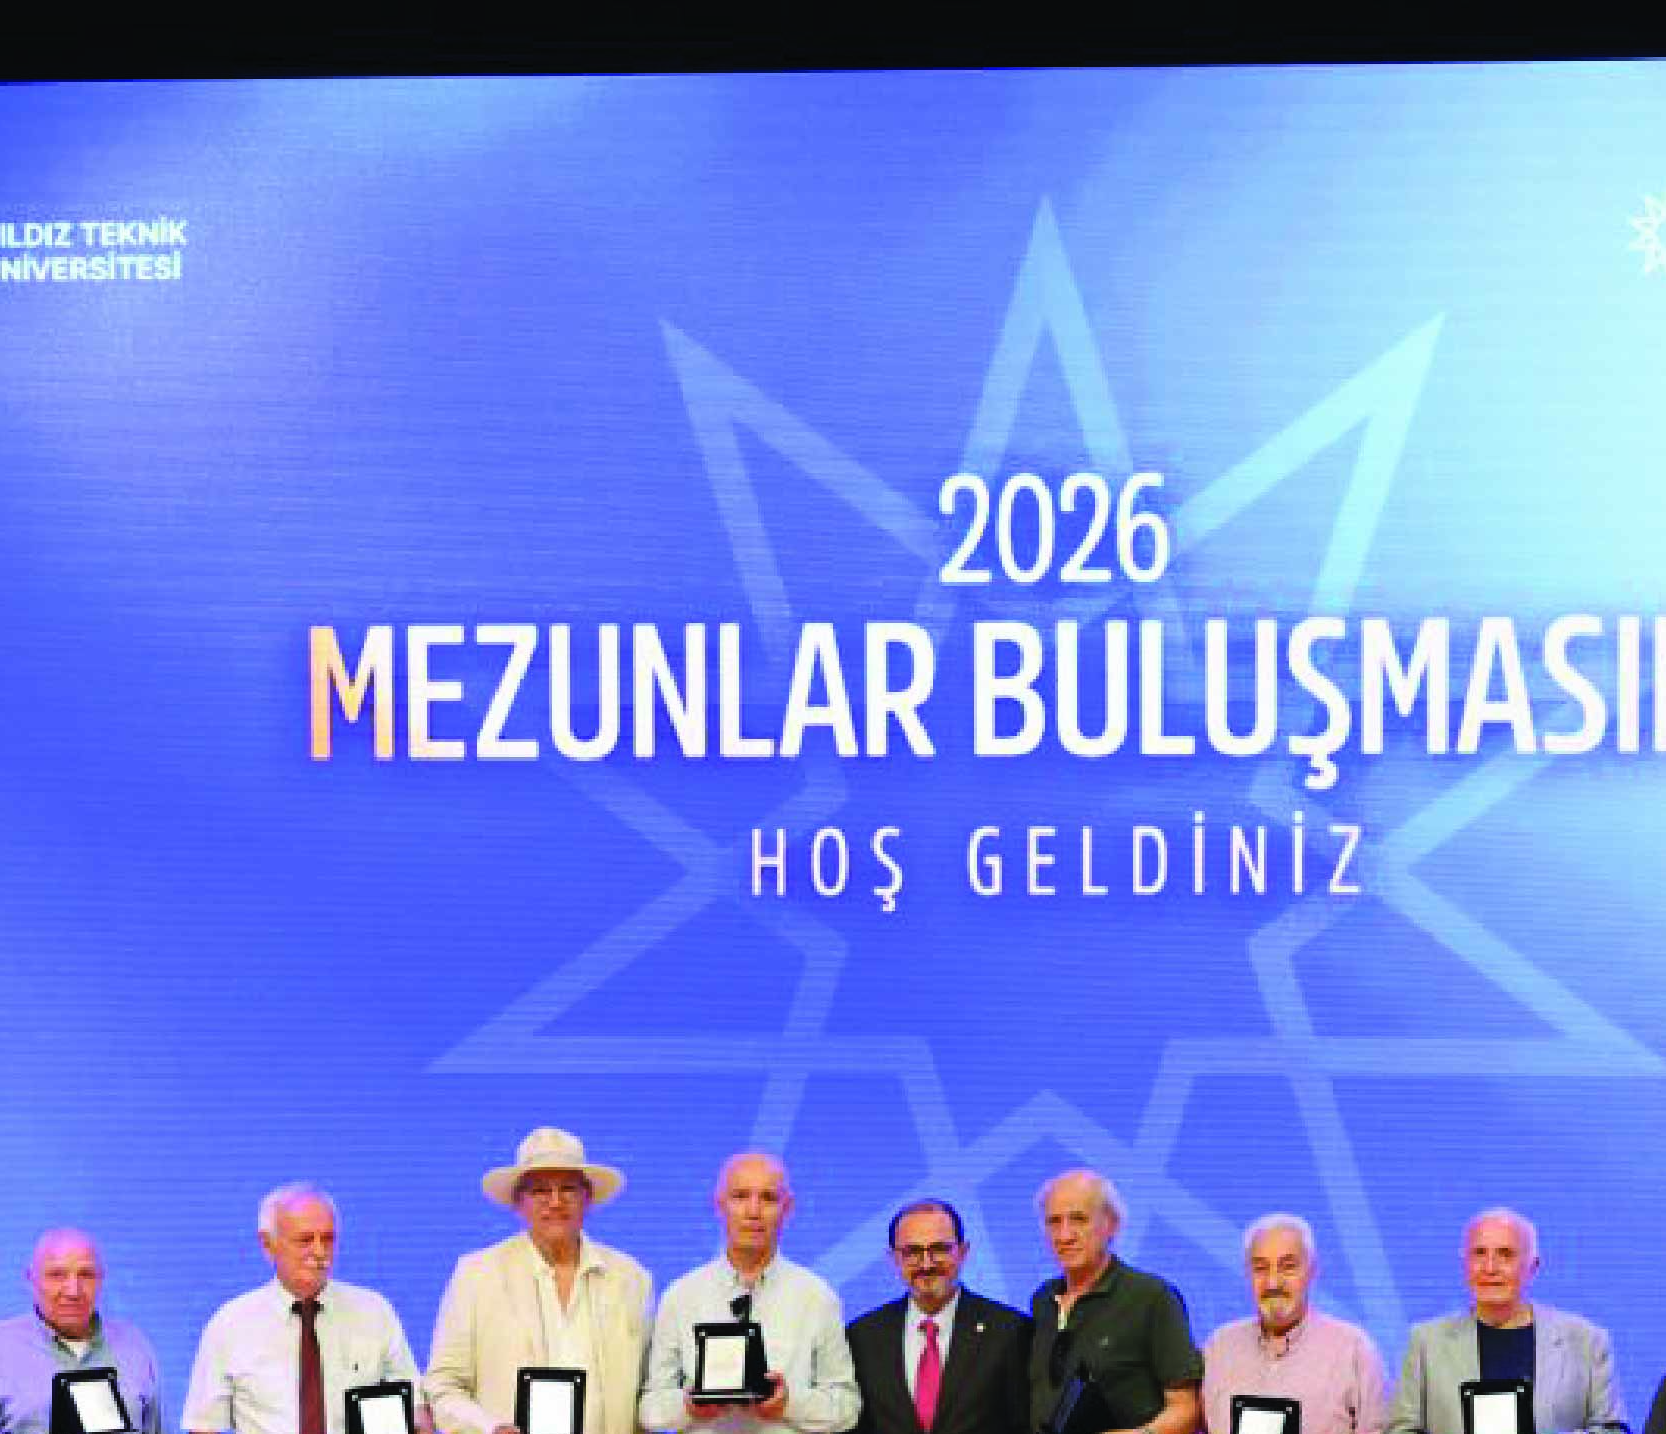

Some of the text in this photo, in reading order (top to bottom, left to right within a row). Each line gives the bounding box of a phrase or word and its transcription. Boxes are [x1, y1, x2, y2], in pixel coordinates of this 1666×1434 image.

[83, 216, 187, 248] TEKNİK
[937, 472, 1172, 587] 2026
[309, 622, 935, 761] MEZUNLAR
[751, 811, 1363, 912] HOŞ GELDİNİZ
